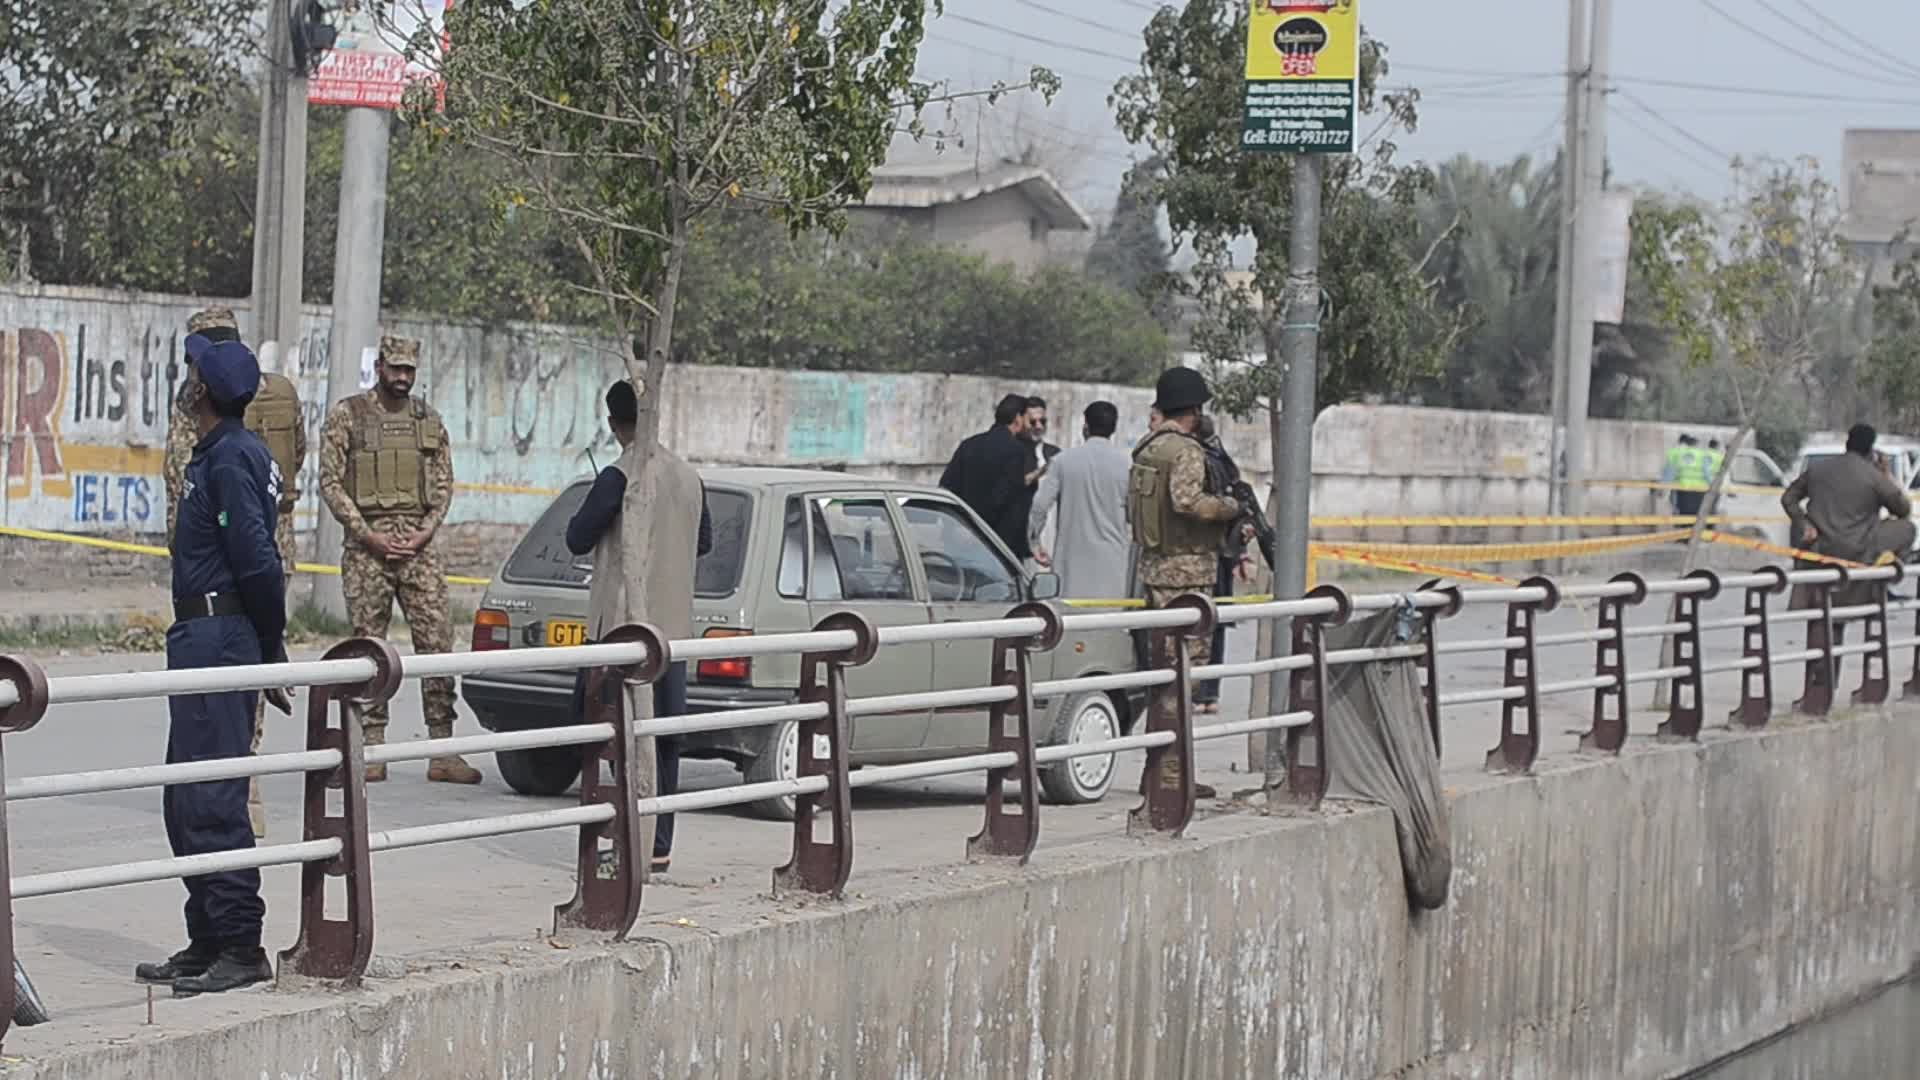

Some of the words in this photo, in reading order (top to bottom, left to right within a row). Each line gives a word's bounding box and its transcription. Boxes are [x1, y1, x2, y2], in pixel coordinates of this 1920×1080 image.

[320, 65, 395, 81] MISSIONS
[1281, 58, 1317, 75] OPEN
[74, 324, 182, 426] Instit
[74, 474, 151, 522] IELTS
